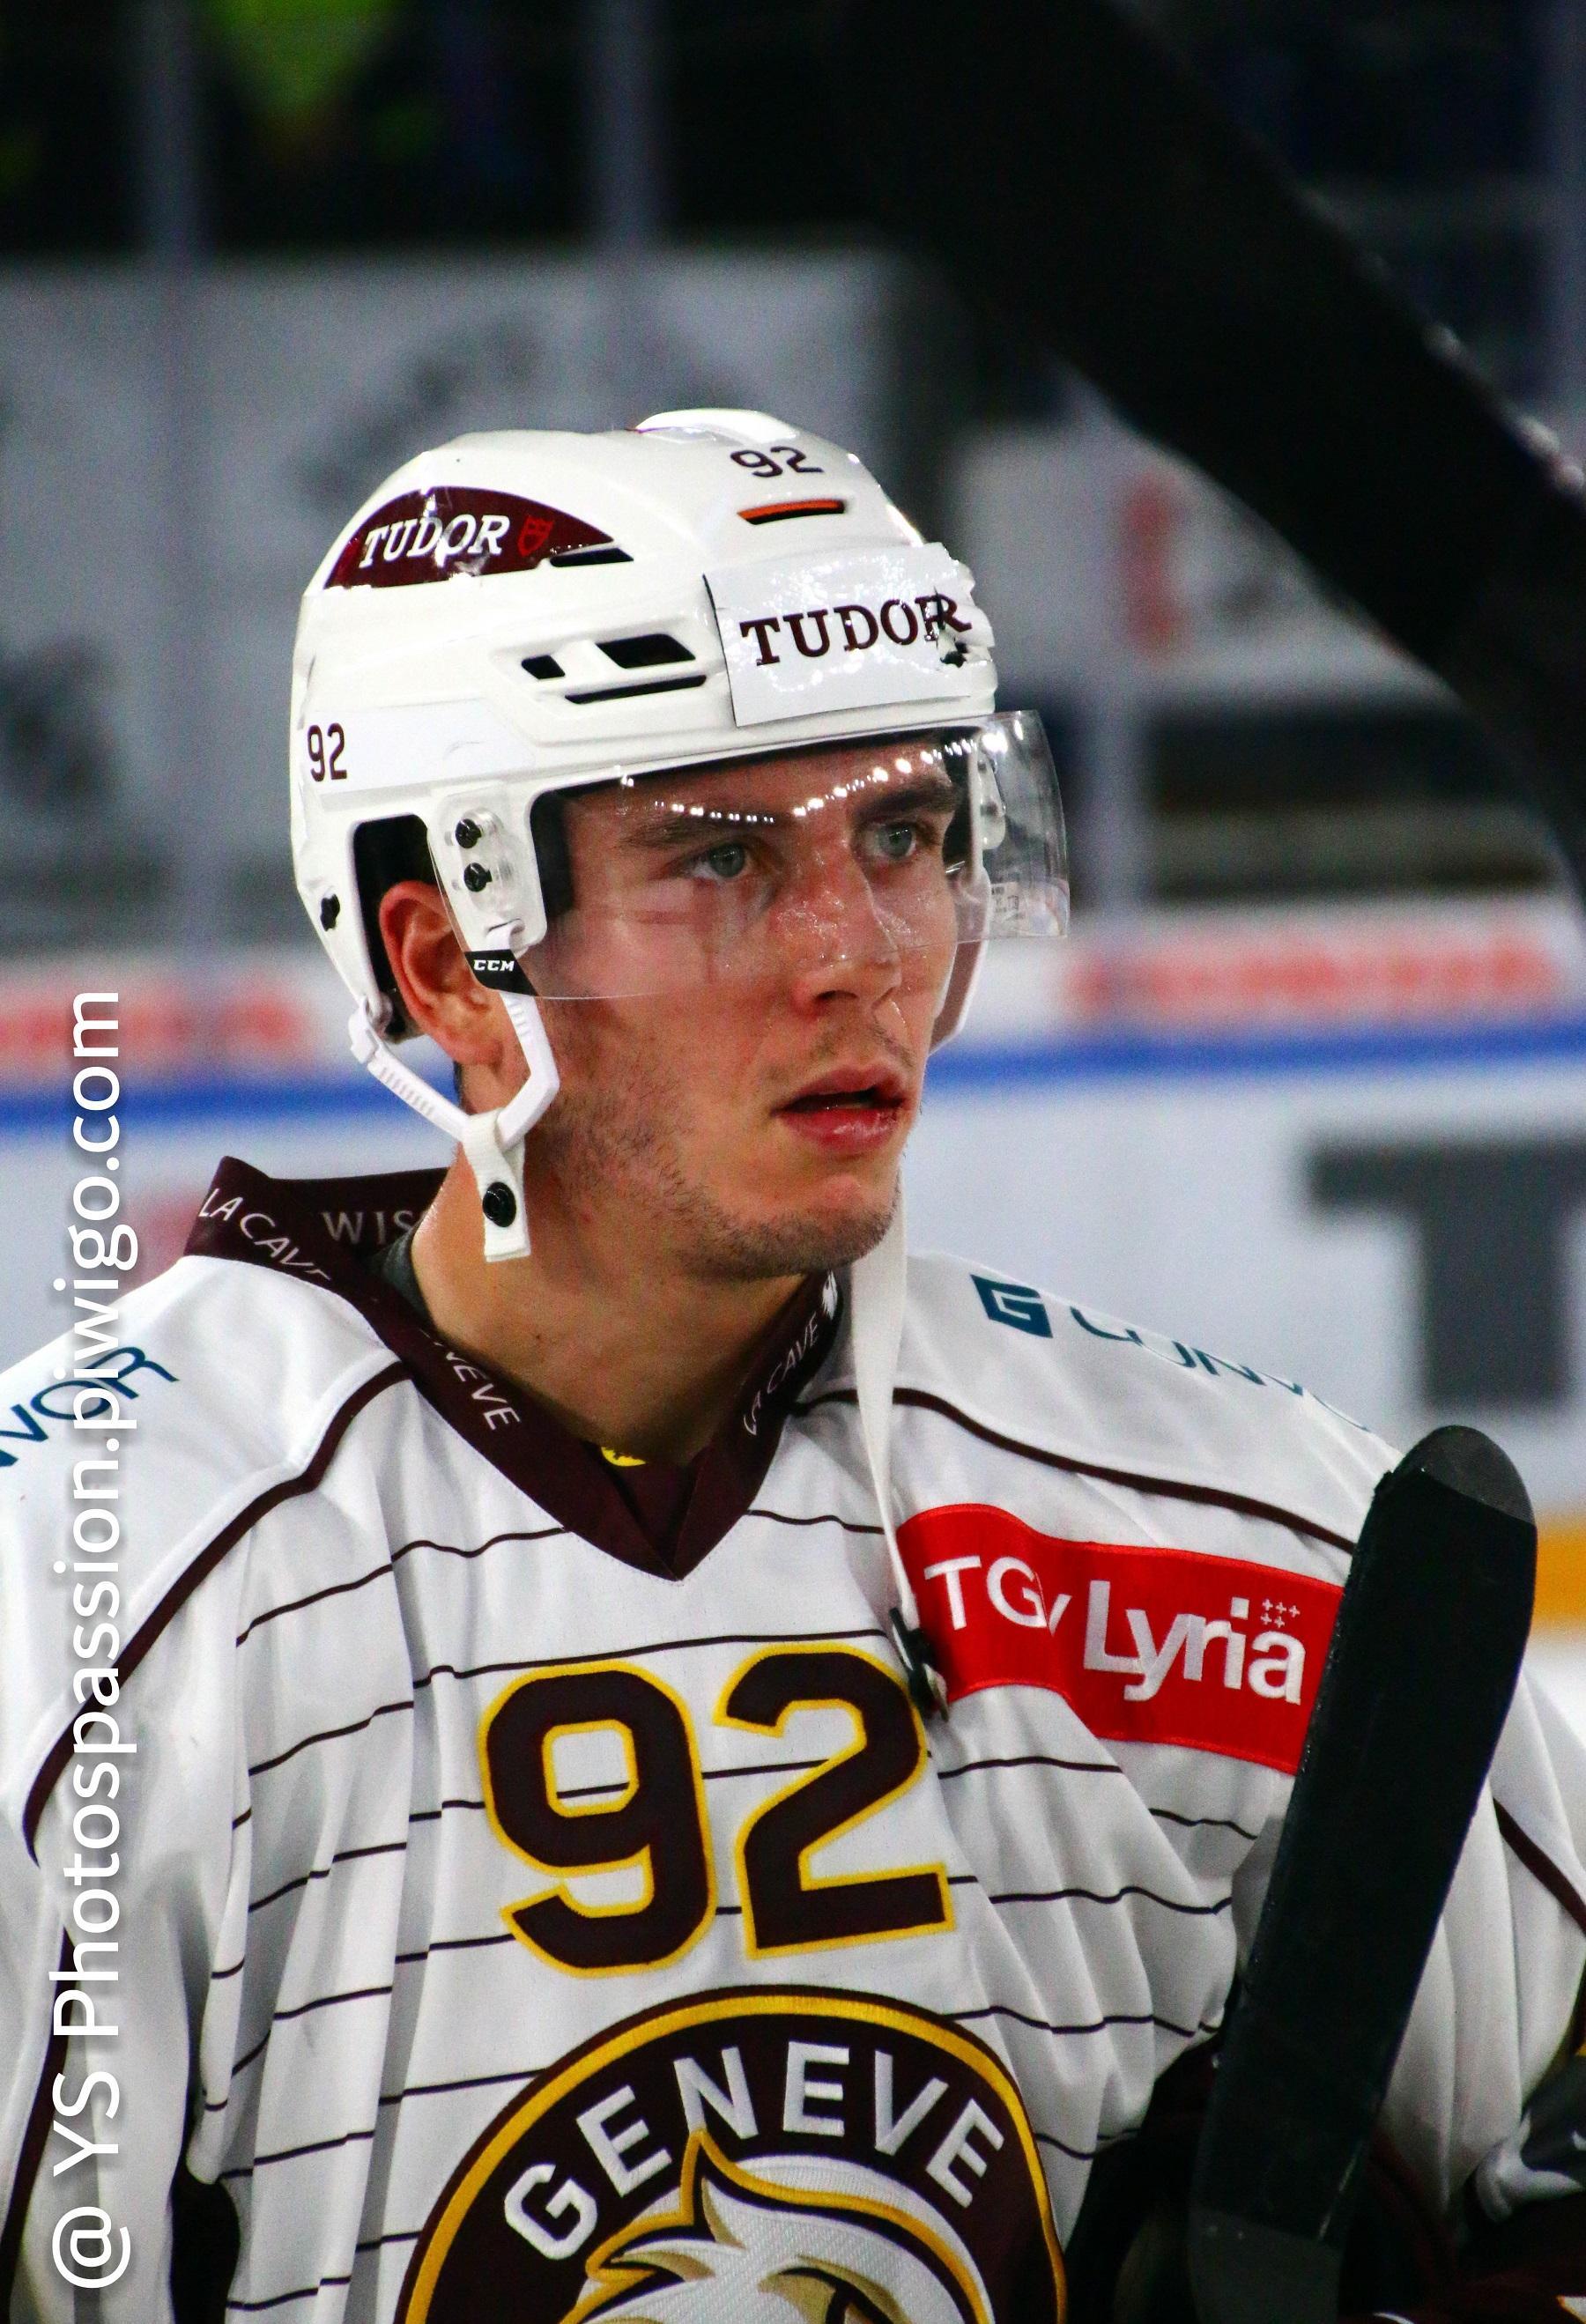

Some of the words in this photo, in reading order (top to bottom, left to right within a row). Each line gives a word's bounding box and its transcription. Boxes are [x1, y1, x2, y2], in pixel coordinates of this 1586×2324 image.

[730, 445, 825, 477] 92
[358, 513, 510, 569] TUDOR
[738, 593, 973, 667] TUDOR
[306, 722, 349, 782] 92
[472, 958, 515, 972] CCM
[198, 1188, 244, 1221] LA
[240, 1211, 333, 1281] CAV
[321, 1210, 427, 1245] WIS
[418, 1328, 522, 1431] EVE
[767, 1311, 819, 1395] CAVE
[0, 1346, 180, 1468] VOR
[1083, 1579, 1307, 1706] Lyria
[478, 1643, 956, 1979] 92
[504, 2040, 1004, 2261] GENEVE
